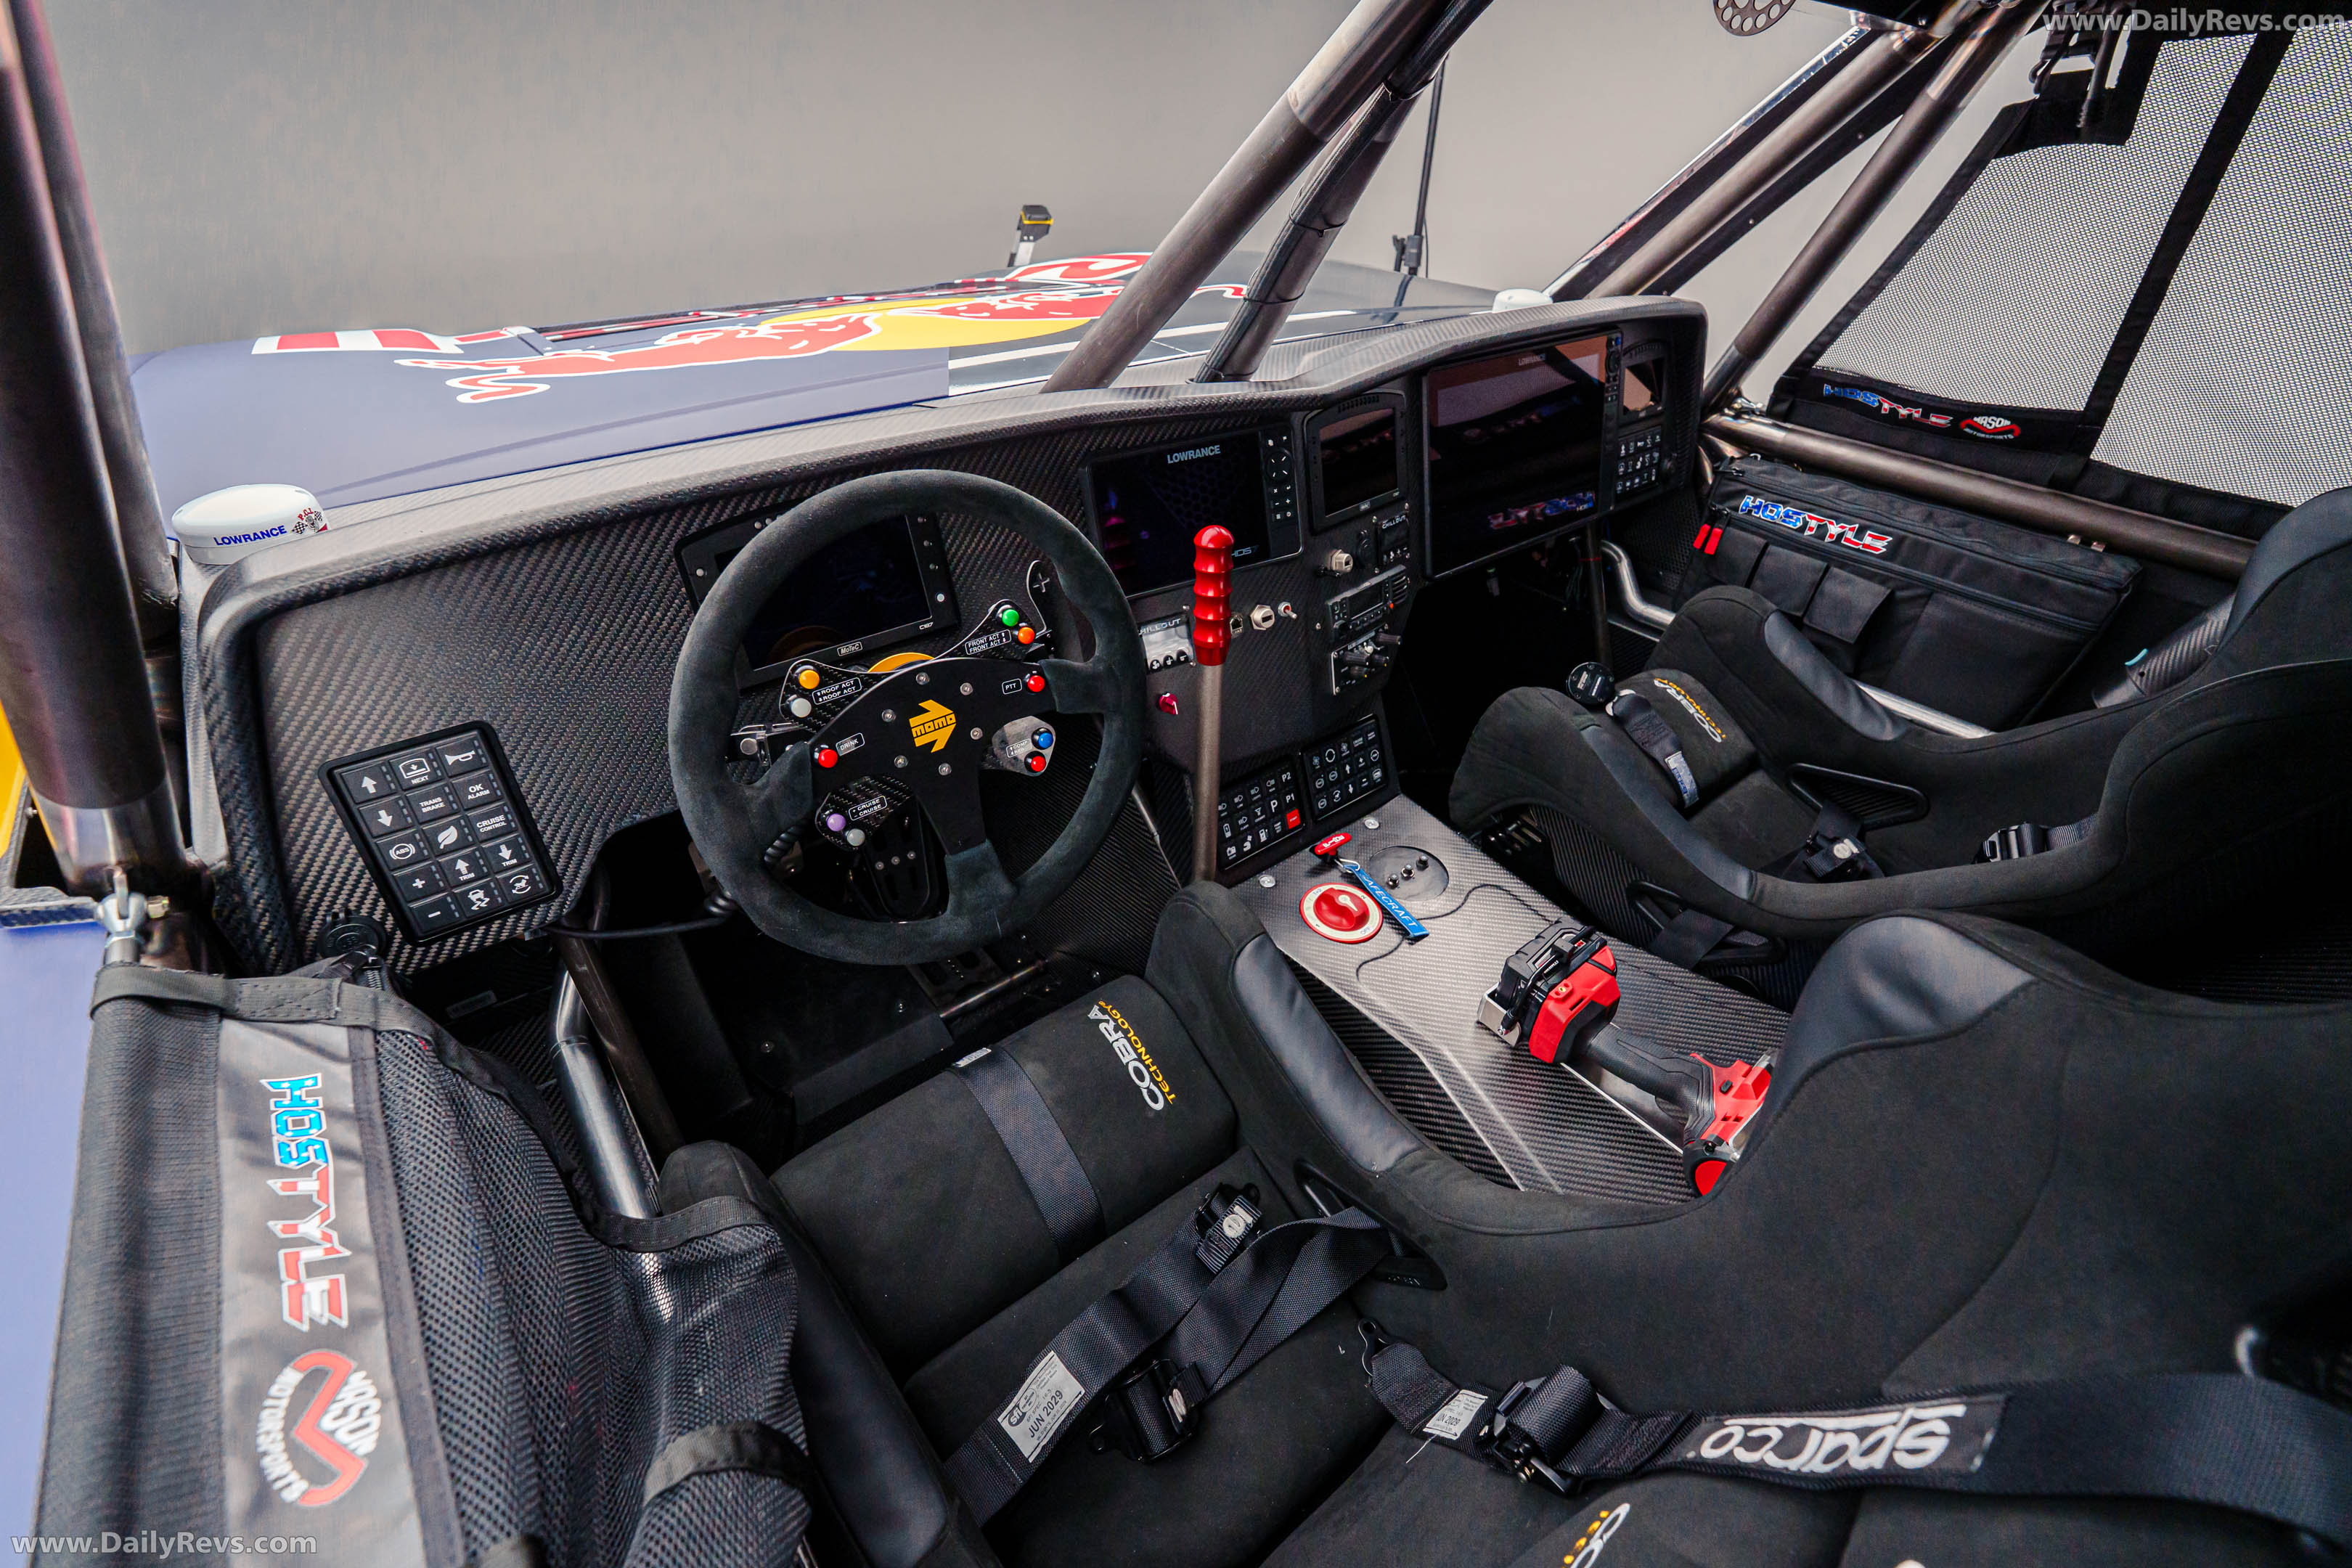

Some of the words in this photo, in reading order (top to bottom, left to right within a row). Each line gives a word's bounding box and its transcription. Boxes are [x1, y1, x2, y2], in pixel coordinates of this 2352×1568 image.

[1824, 384, 1953, 428] HOSTYLE
[1167, 445, 1221, 464] LOWRANCE
[1739, 495, 1892, 554] HOSTYLE
[213, 525, 287, 546] LOWRANCE
[968, 638, 987, 648] FRONT
[969, 644, 988, 653] FRONT
[821, 685, 839, 695] ROOF
[822, 691, 841, 701] ROOF
[840, 738, 859, 751] DRINK
[411, 775, 429, 785] NEXT
[1282, 772, 1291, 782] P2
[468, 783, 484, 793] OK
[467, 789, 490, 800] ALARM
[1286, 793, 1294, 803] P1
[419, 797, 442, 807] TRANS
[421, 801, 446, 813] BRAKE
[857, 799, 880, 811] CRUISE
[1270, 800, 1278, 813] P
[859, 804, 882, 816] CRUISE
[476, 814, 506, 828] CRUISE
[479, 821, 507, 833] CONTROL
[502, 858, 518, 867] TRIM
[459, 873, 475, 881] TRIM
[1088, 1005, 1164, 1110] COBRA
[1101, 1002, 1176, 1105] TECHNOLOGY
[259, 1073, 351, 1332] HOSTYLE
[1029, 1414, 1045, 1437] JUN
[1043, 1389, 1063, 1416] 2029
[256, 1365, 309, 1503] MOTORSPORTS
[1699, 1405, 1966, 1474] sparco
